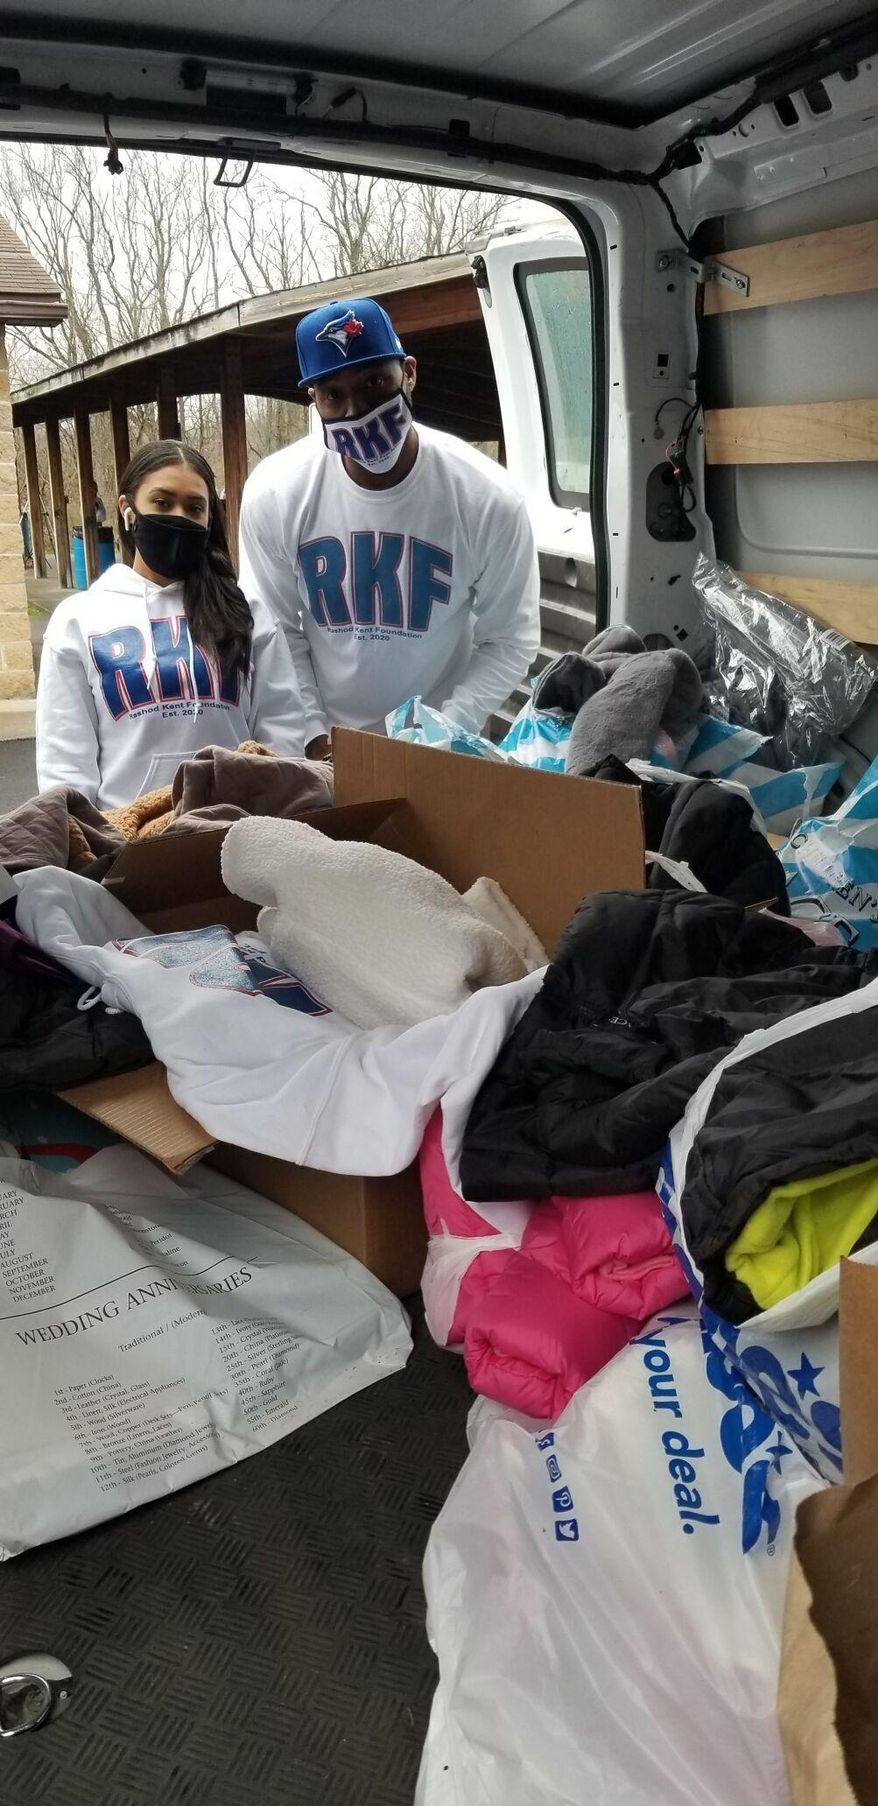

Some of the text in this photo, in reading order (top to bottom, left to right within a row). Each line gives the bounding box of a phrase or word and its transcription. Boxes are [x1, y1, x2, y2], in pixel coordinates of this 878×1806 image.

[330, 403, 406, 460] RKF
[298, 530, 453, 632] RKF
[375, 626, 423, 639] Foundation
[162, 703, 185, 711] Kent
[162, 711, 180, 719] Est.
[0, 1252, 33, 1269] AUGUST
[2, 1257, 49, 1279] SEPTEMBER
[5, 1269, 45, 1287] OCTOBER
[8, 1275, 55, 1293] NOVEMBER
[12, 1285, 56, 1303] DECEMBER
[16, 1300, 120, 1347] WEDDING
[117, 1328, 164, 1354] Traditional
[76, 1398, 101, 1409] Leather
[630, 1328, 721, 1535] your deal.
